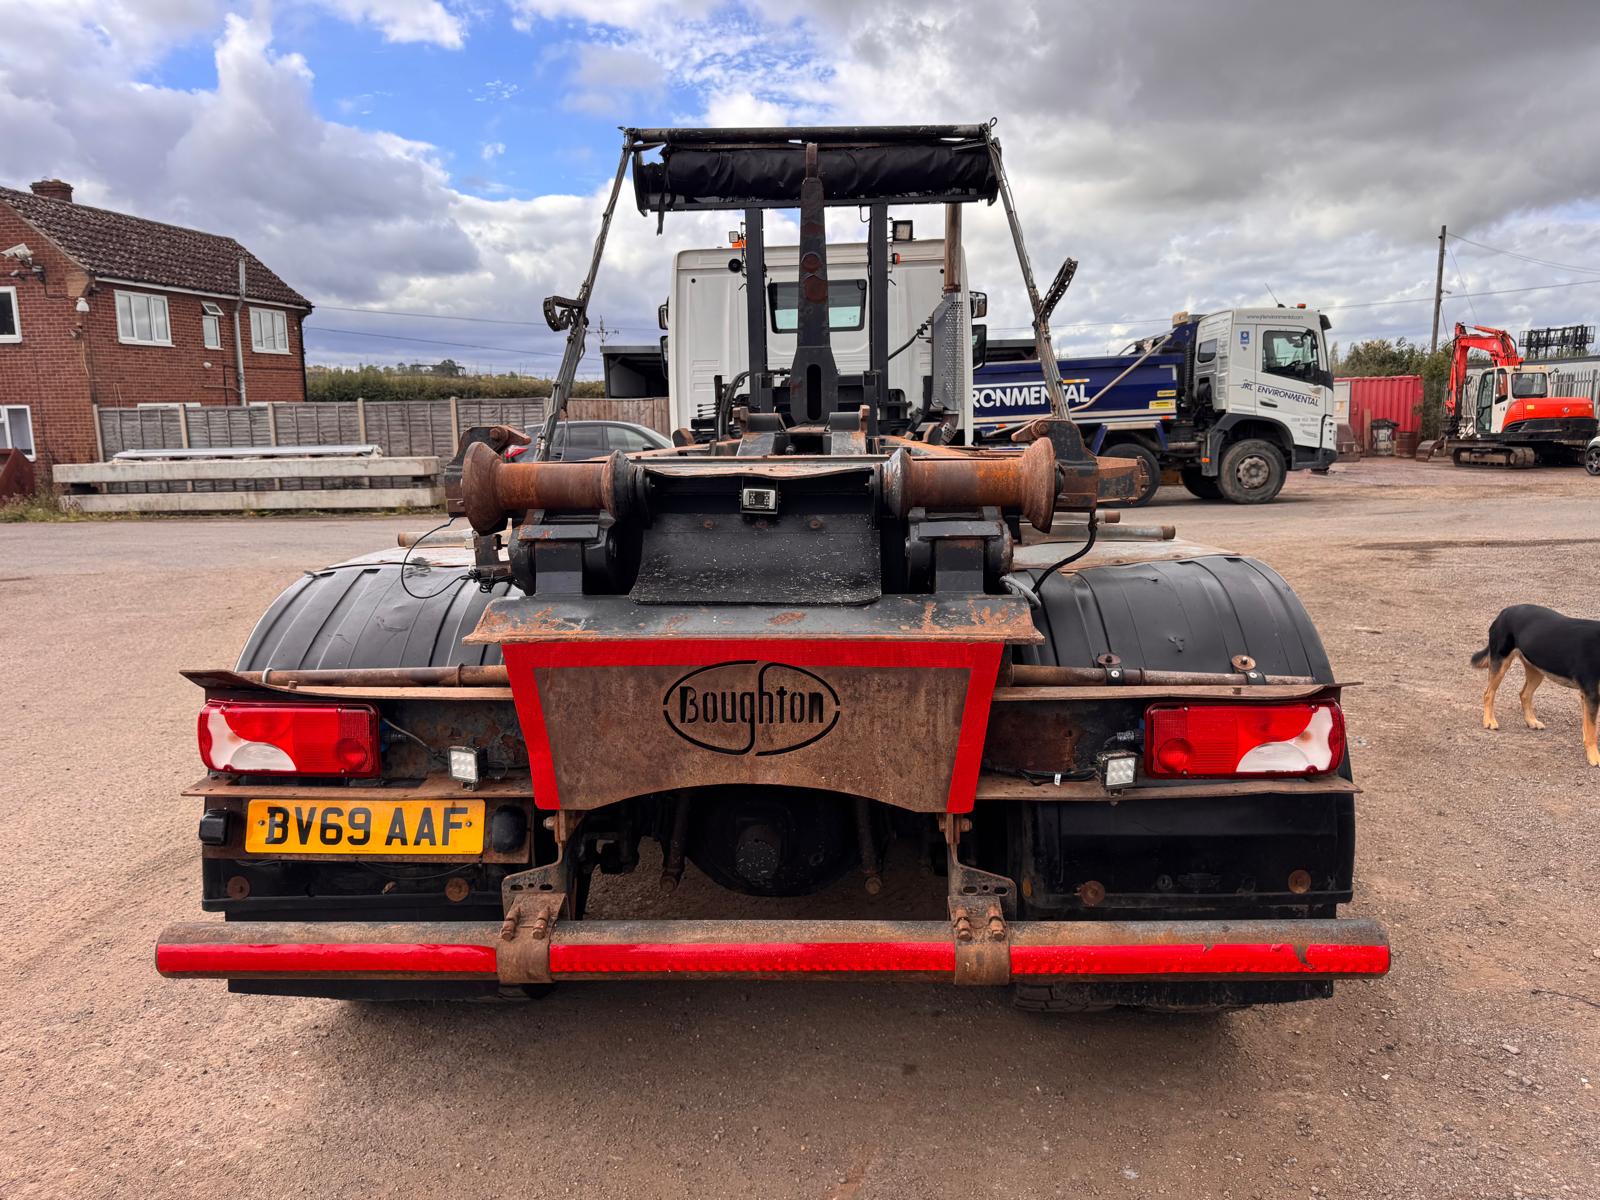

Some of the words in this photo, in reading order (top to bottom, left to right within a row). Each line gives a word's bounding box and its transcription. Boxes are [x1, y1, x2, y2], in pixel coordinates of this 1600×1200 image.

[1240, 382, 1254, 391] JRL
[1257, 385, 1319, 407] ENVIRONMENTAL
[679, 684, 824, 726] Boughton
[264, 806, 372, 845] BV69
[385, 807, 469, 846] AAF
